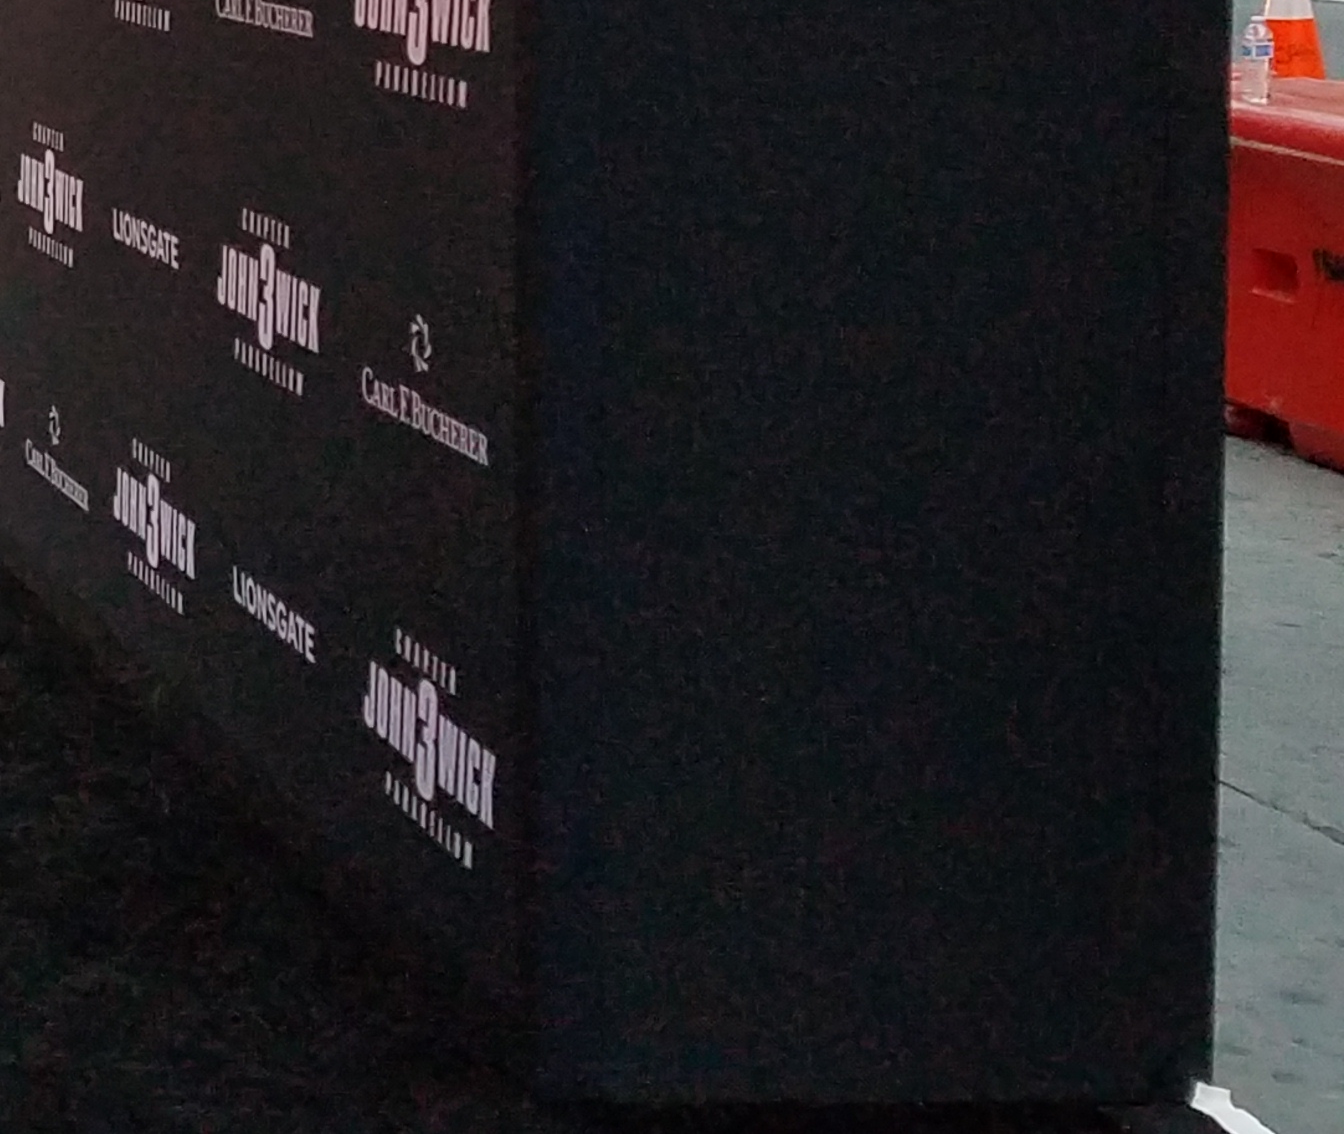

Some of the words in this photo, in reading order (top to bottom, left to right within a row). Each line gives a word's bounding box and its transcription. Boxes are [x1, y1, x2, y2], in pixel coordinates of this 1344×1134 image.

[17, 153, 43, 209] JOHN
[44, 149, 54, 233] 3
[56, 170, 83, 231] WICK
[113, 208, 178, 268] LIONSGATE
[217, 245, 257, 318] JOHN
[258, 243, 274, 349] 3
[276, 271, 320, 352] WICK
[361, 366, 397, 417] CARL
[411, 390, 487, 465] BUCHERER
[113, 467, 145, 536] JOHN
[146, 473, 158, 567] 3
[161, 504, 195, 578] WICK
[233, 566, 314, 662] LIONSGATE
[363, 661, 414, 759] JOHN
[416, 679, 437, 800] 3
[439, 716, 495, 828] WICK
